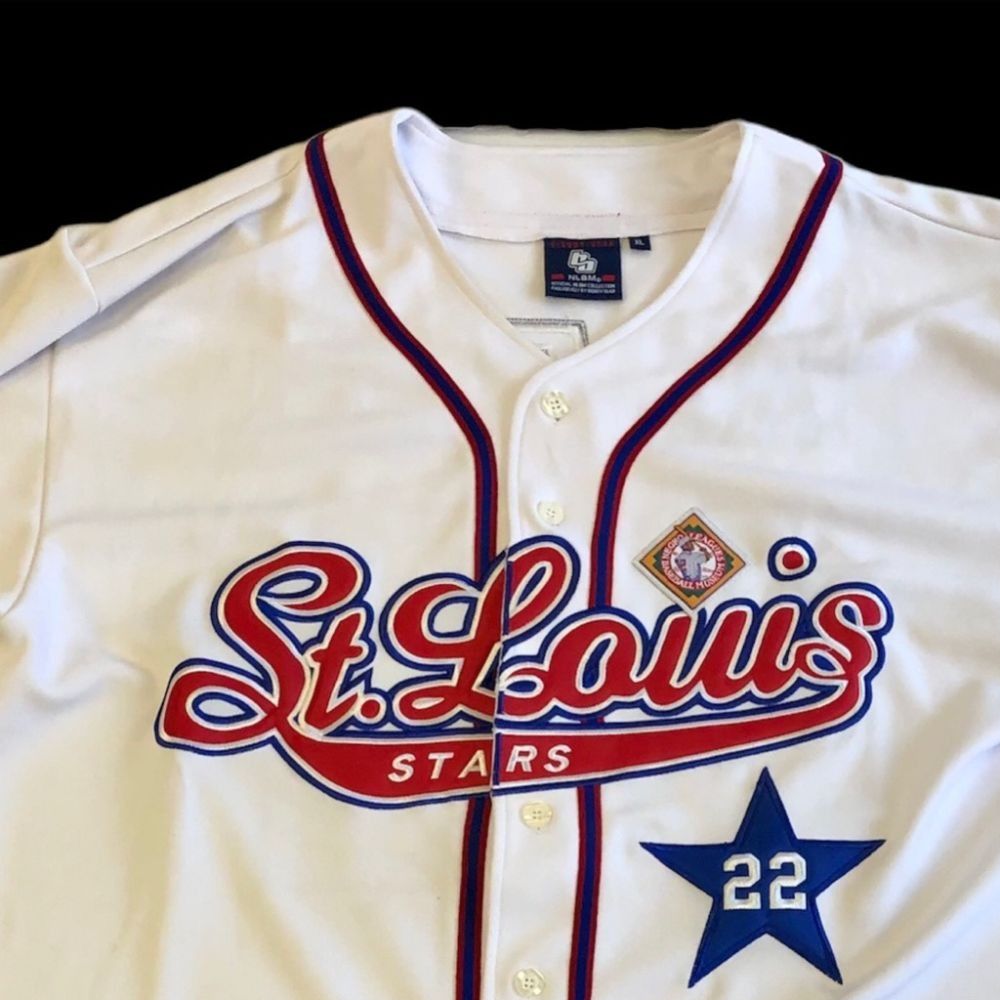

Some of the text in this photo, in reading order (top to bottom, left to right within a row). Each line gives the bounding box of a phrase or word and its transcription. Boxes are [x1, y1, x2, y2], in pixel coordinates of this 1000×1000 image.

[380, 534, 894, 735] Louis
[388, 744, 572, 783] STARS
[723, 853, 807, 911] 22
